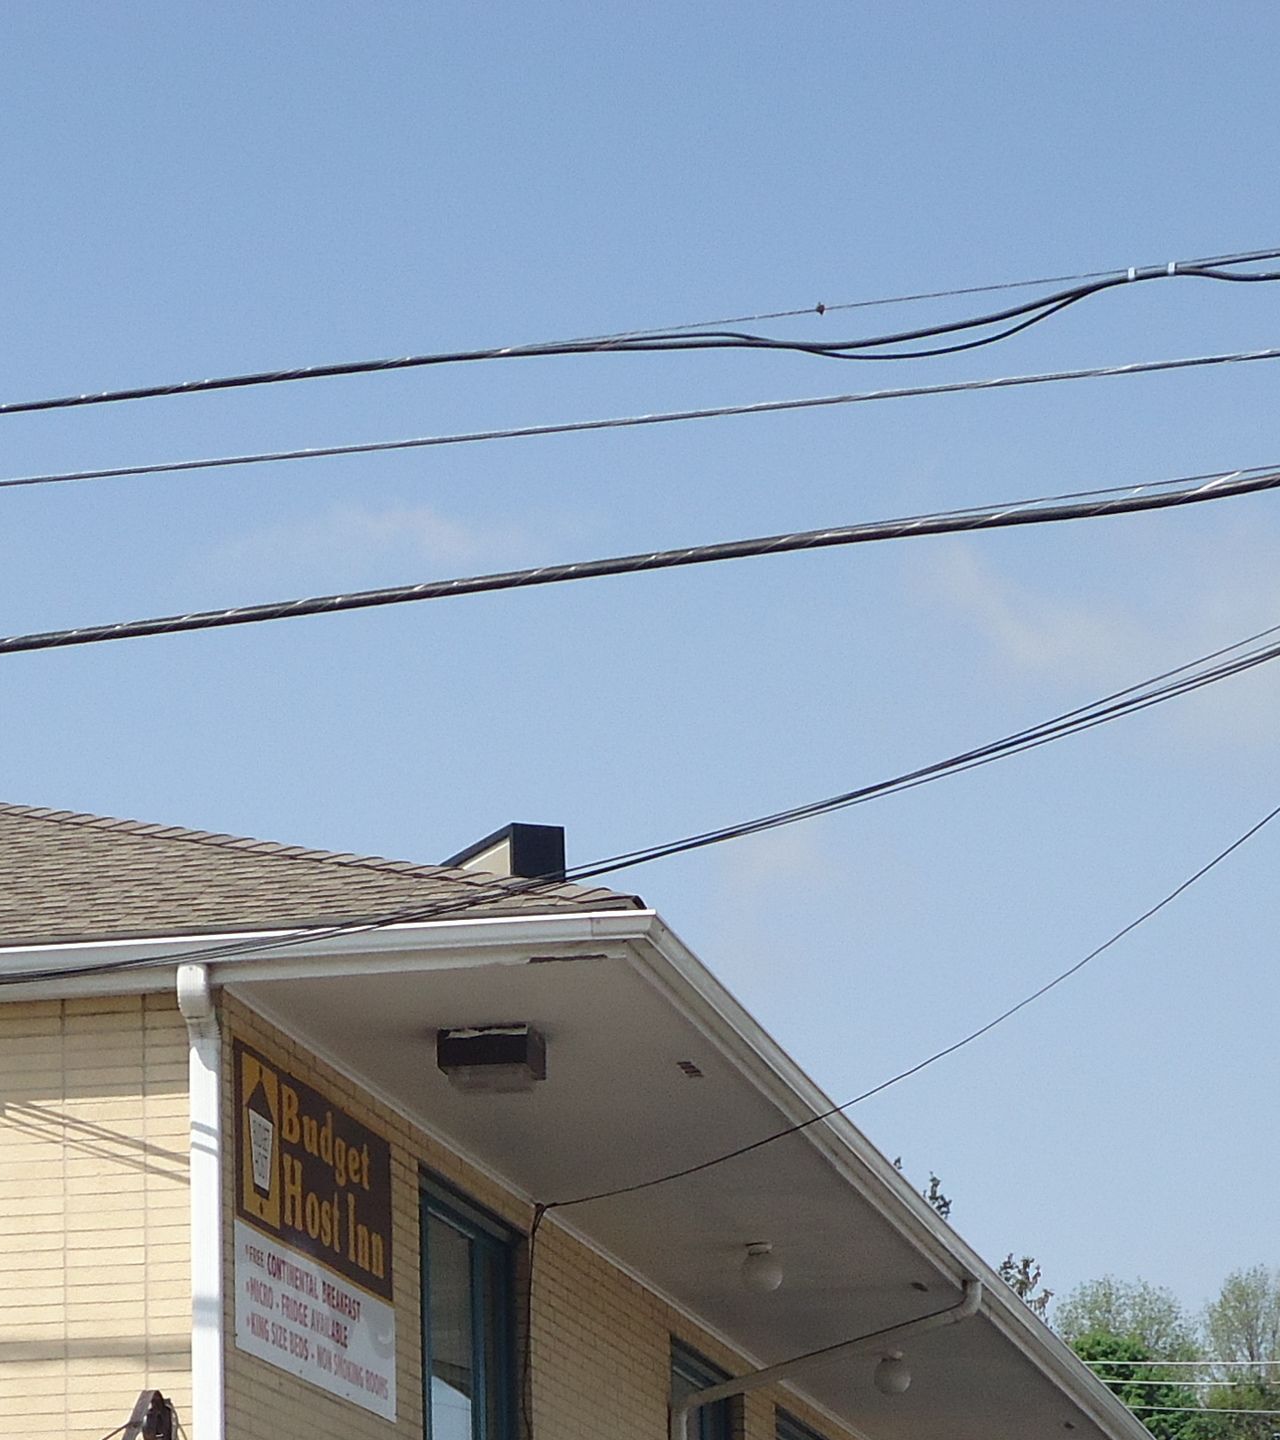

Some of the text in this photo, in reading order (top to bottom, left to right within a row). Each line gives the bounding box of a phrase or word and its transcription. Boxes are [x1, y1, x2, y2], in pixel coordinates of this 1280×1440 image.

[281, 1081, 371, 1192] Budget
[283, 1153, 384, 1279] Host Inn
[267, 1252, 319, 1299] CONTINENTAL
[322, 1280, 361, 1323] BREAKFAST
[281, 1293, 308, 1328] FRIDGE
[310, 1309, 348, 1348] AVAILABLE
[271, 1322, 288, 1350] SIZE
[289, 1330, 308, 1361] BEDS
[334, 1354, 364, 1387] SMOKING
